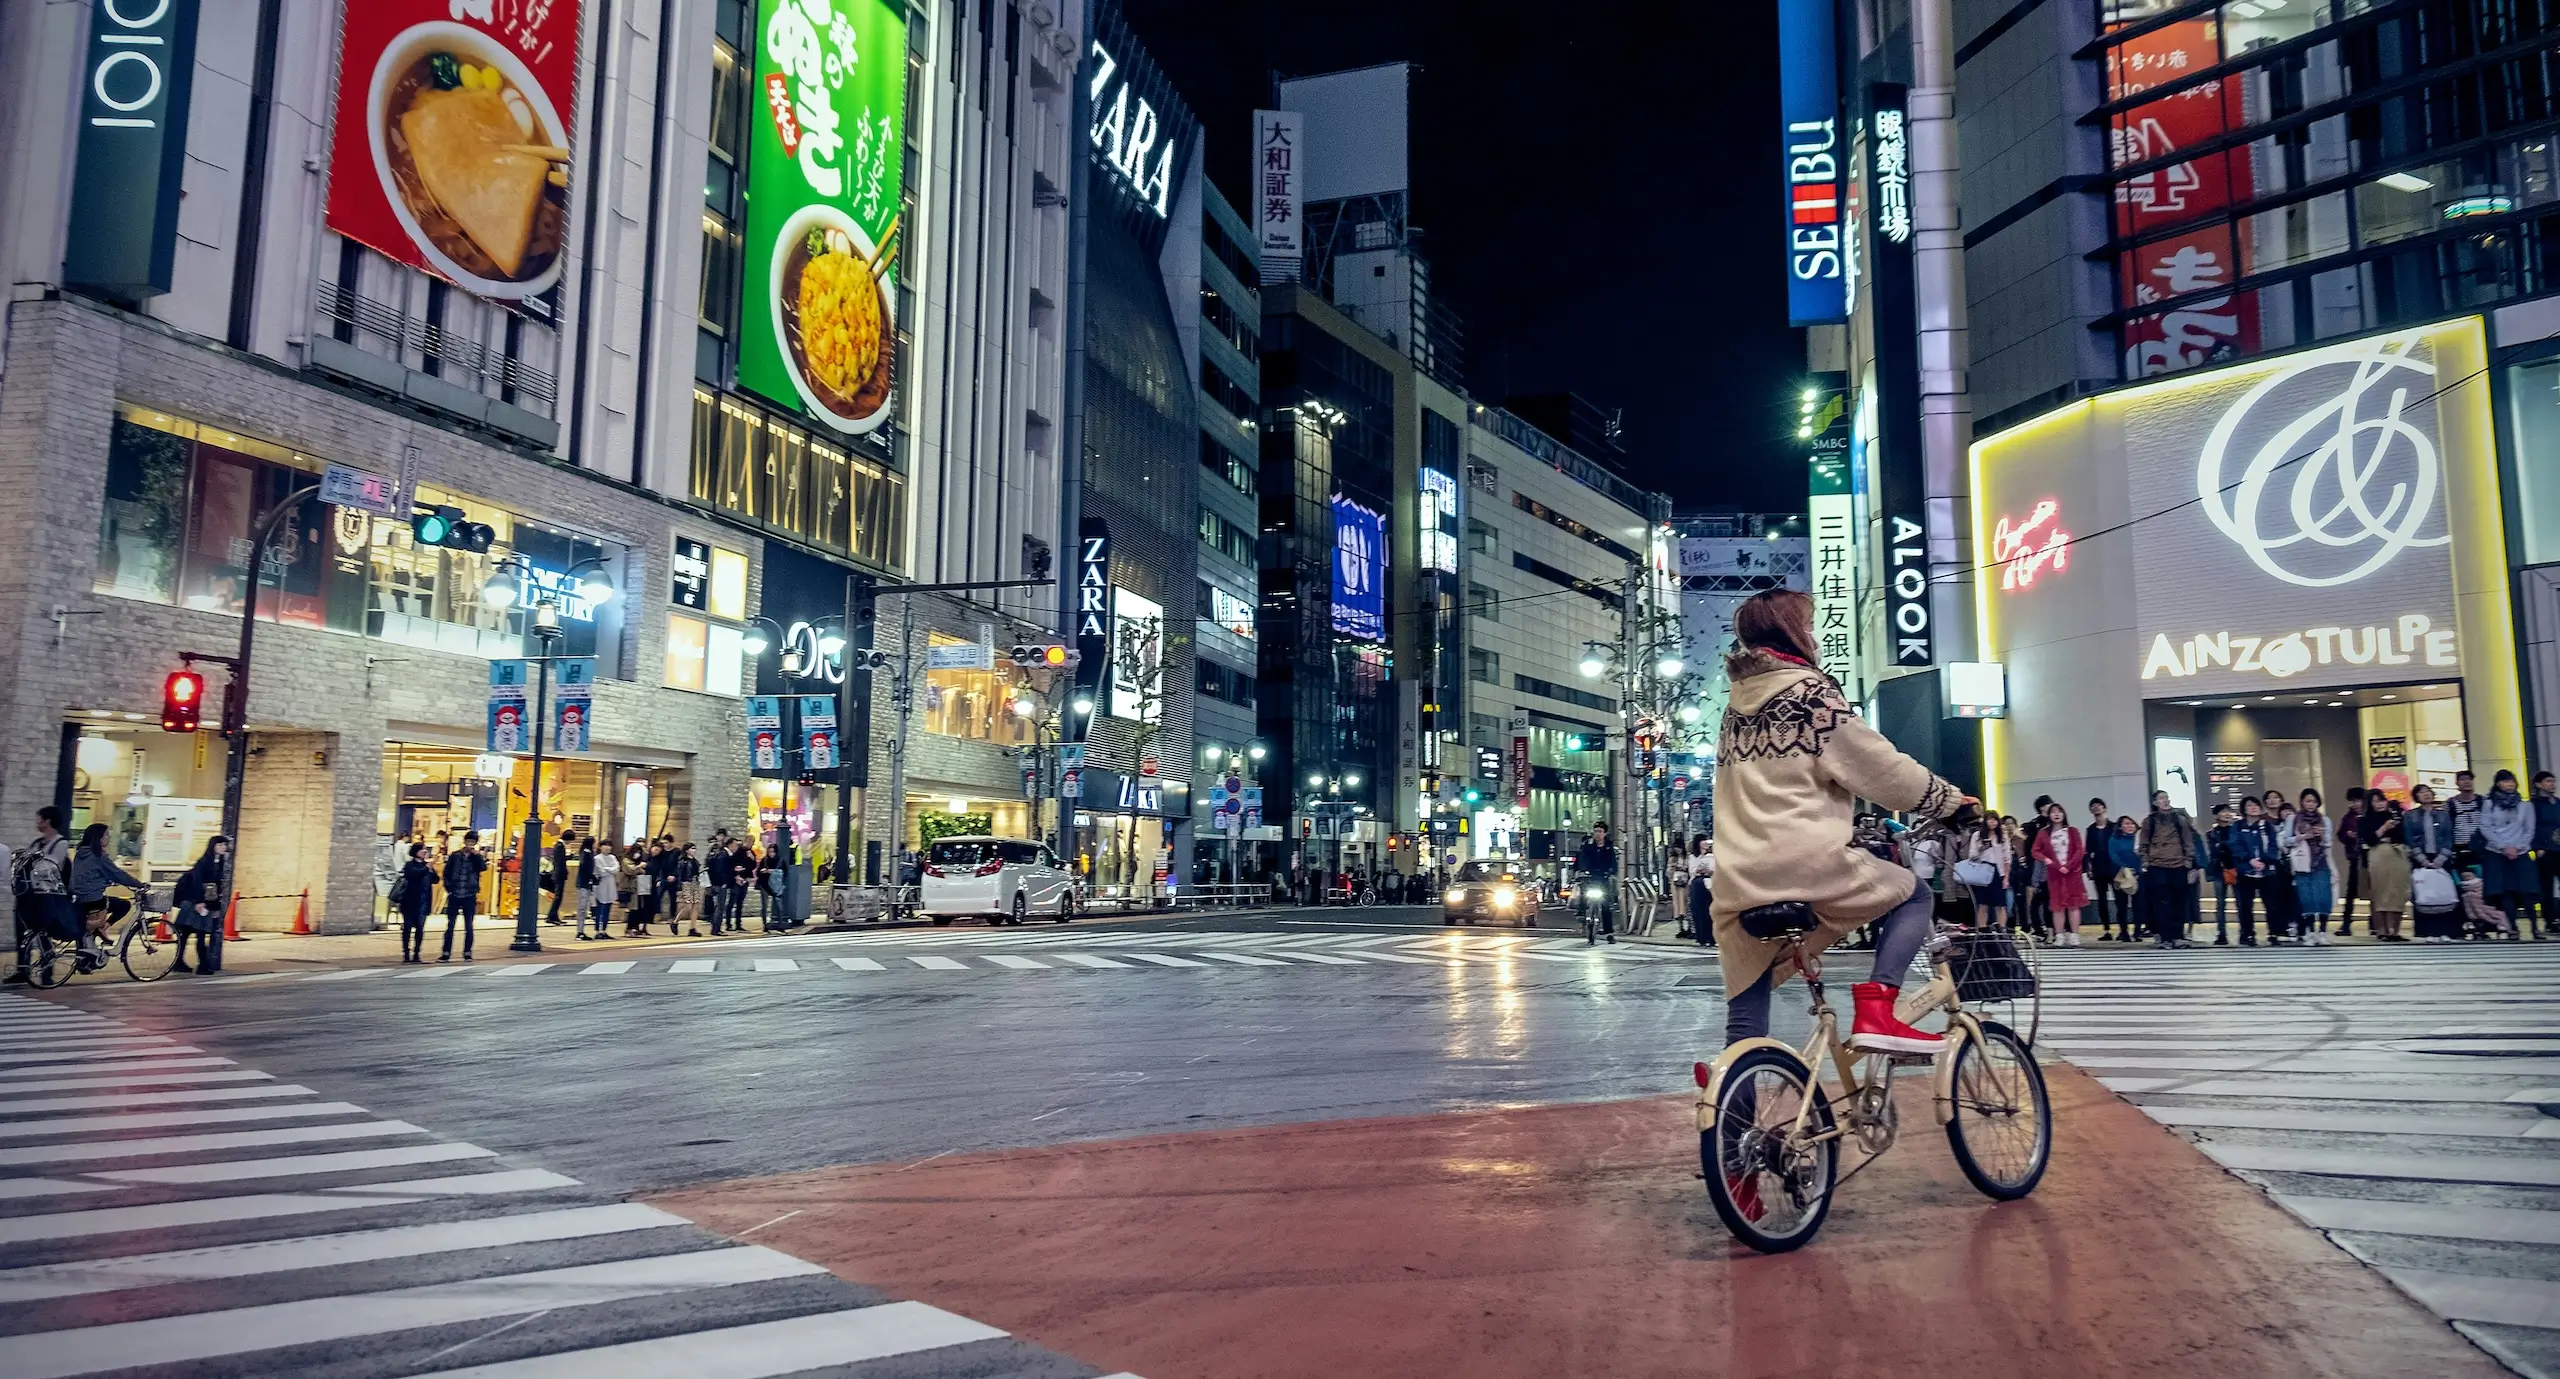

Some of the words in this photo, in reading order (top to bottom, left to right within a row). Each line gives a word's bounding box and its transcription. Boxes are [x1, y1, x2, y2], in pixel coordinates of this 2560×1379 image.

[825, 10, 859, 89] 緑の
[769, 79, 797, 146] 天そば
[1090, 39, 1175, 218] ZARA
[1265, 121, 1292, 222] 大和証券
[1789, 116, 1841, 281] SEIBU
[1874, 110, 1911, 244] 眼鏡市場
[1812, 437, 1848, 450] SMBC
[1079, 537, 1107, 636] ZARA
[1819, 516, 1851, 688] 三井住友銀行
[1892, 516, 1929, 661] ALOOK
[2141, 631, 2263, 680] AINZ
[2305, 614, 2457, 666] TULPE
